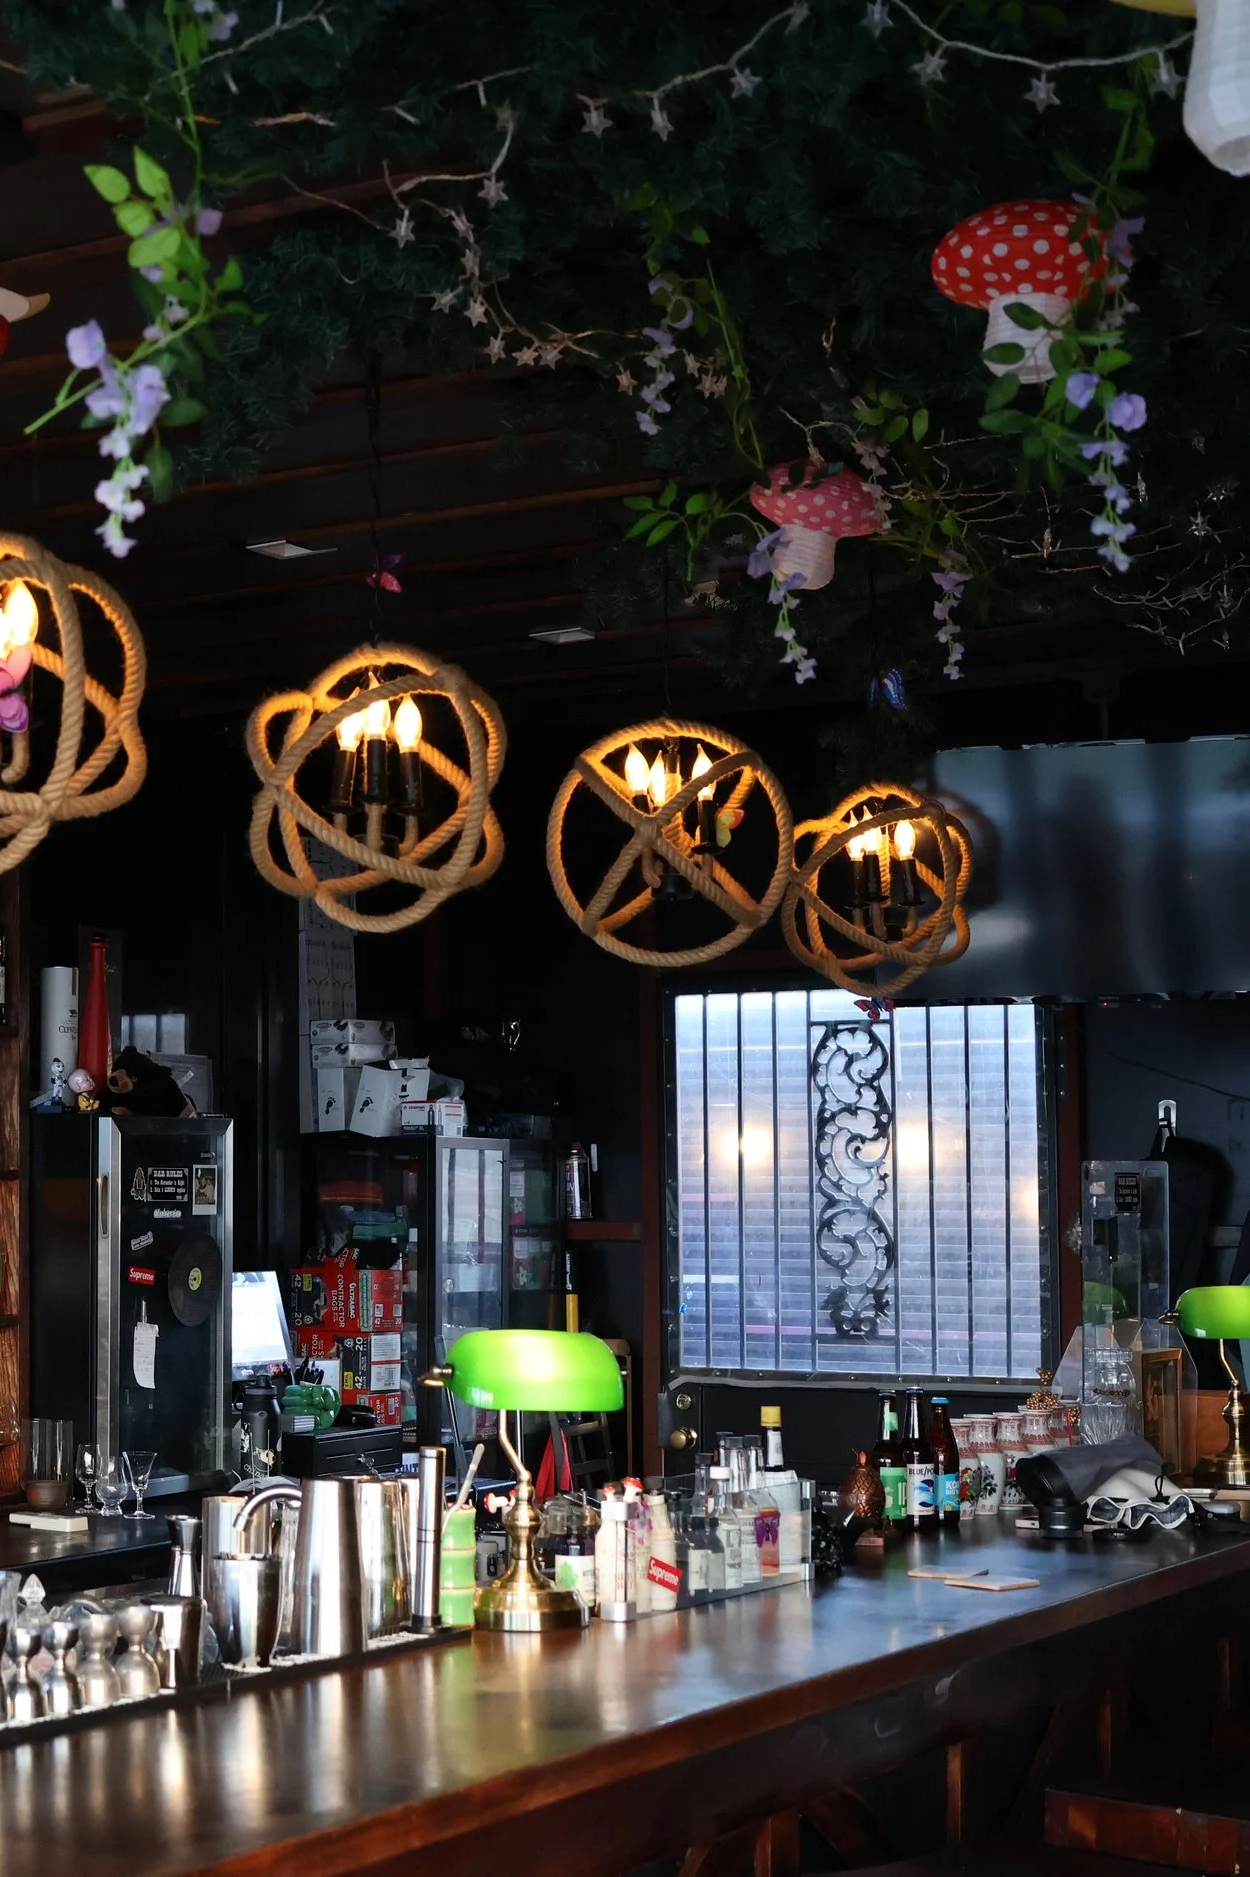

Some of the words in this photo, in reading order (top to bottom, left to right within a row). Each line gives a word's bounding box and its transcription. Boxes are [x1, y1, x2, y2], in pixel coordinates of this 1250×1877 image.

[129, 1268, 155, 1282] Supreme
[294, 1274, 302, 1288] 42
[336, 1274, 346, 1328] CONTRACTOR
[349, 1282, 357, 1320] ULTRASAC
[294, 1312, 303, 1326] 20
[355, 1336, 364, 1351] 20
[355, 1375, 363, 1389] 42
[649, 1559, 680, 1586] Supreme
